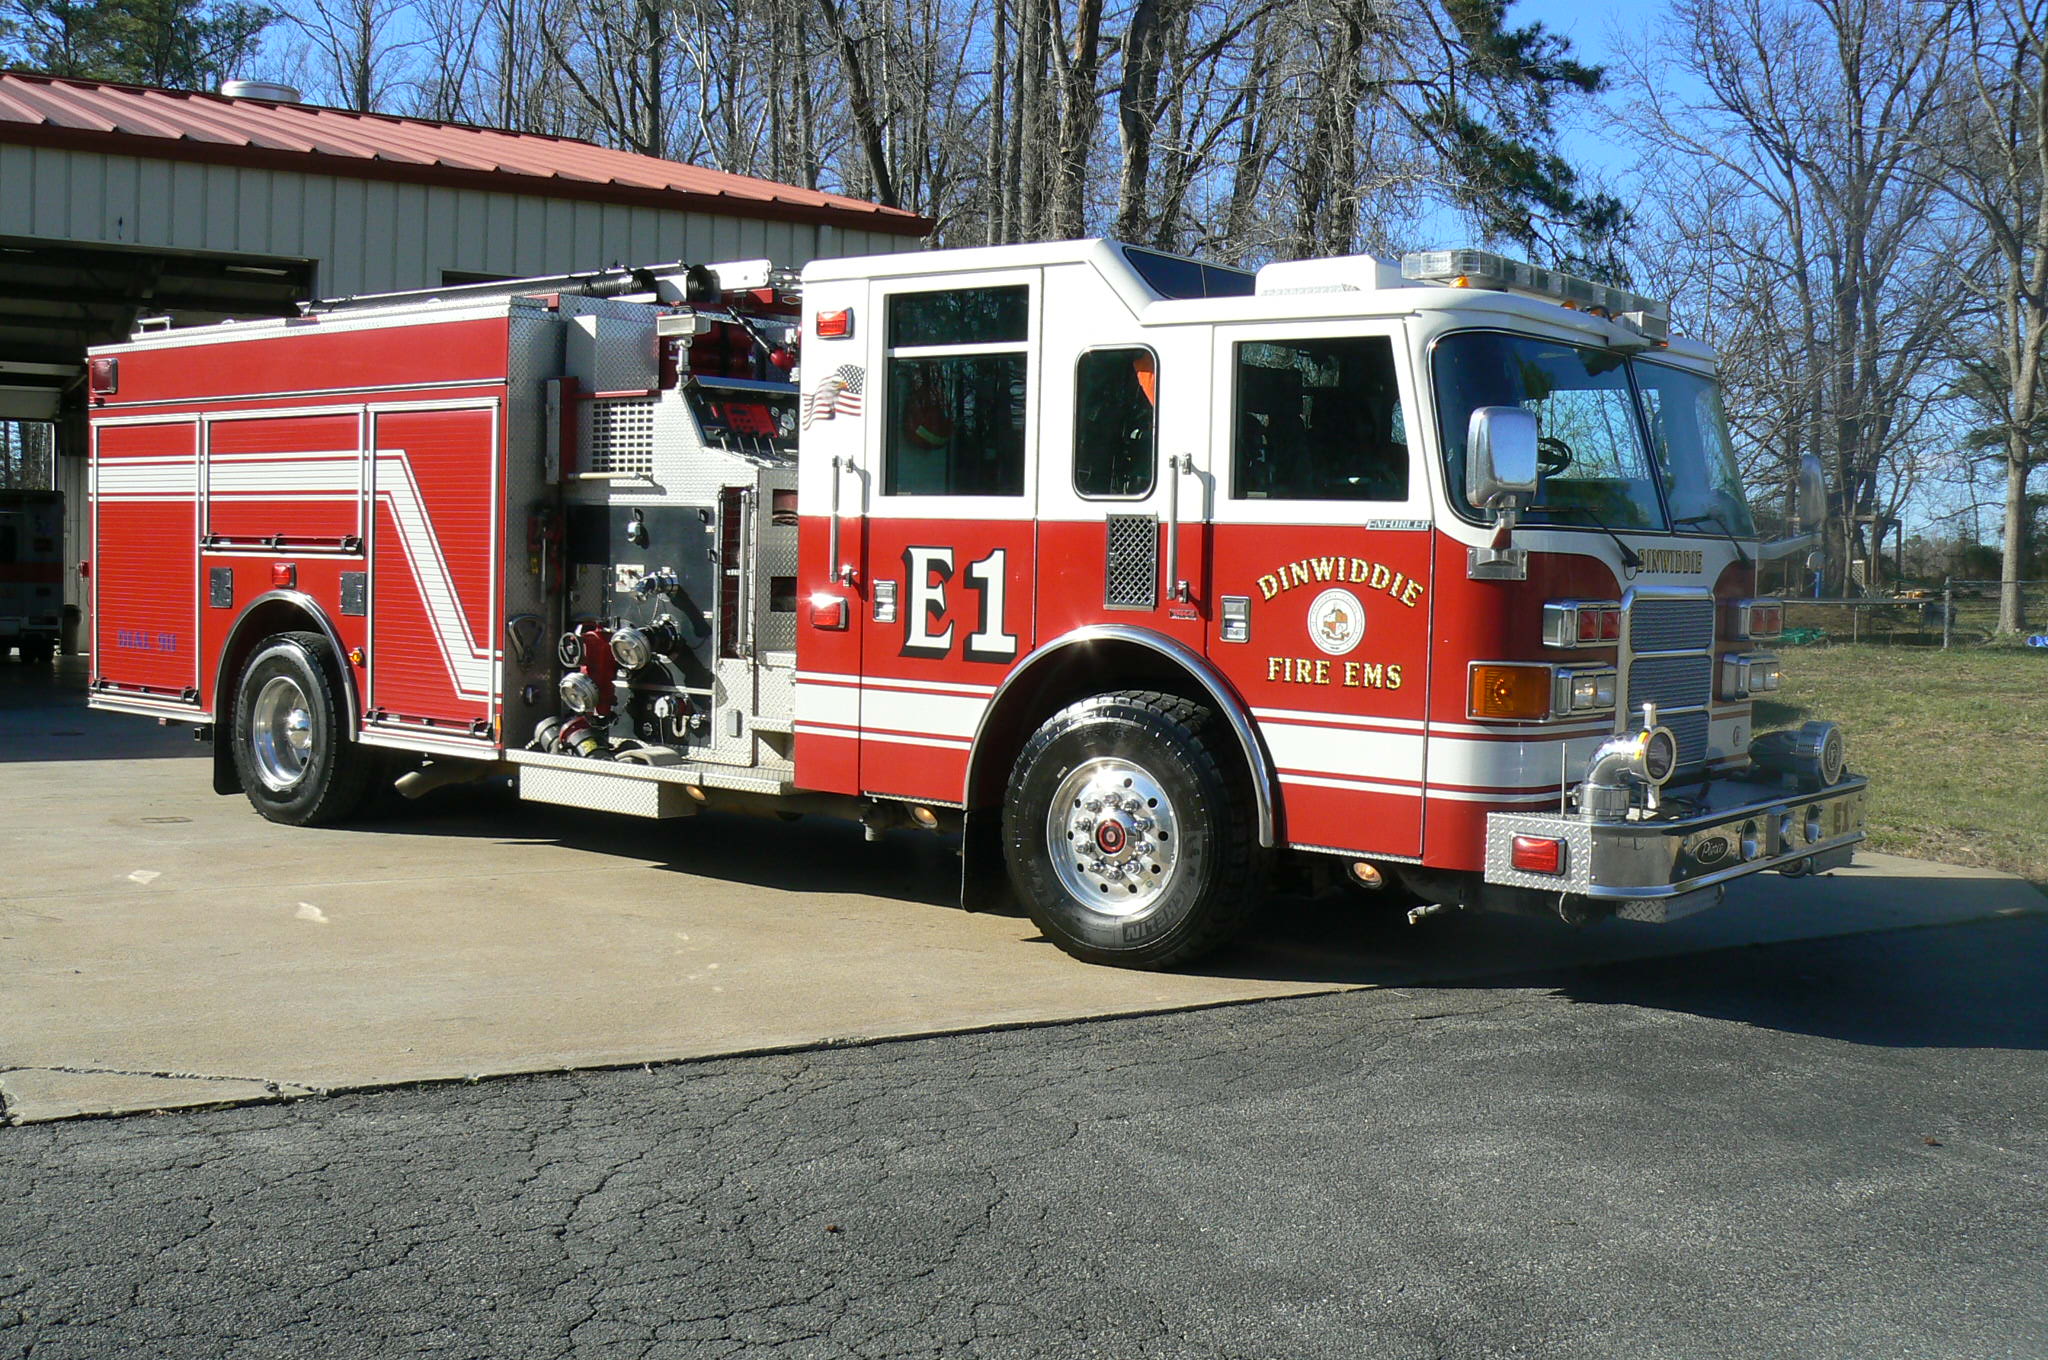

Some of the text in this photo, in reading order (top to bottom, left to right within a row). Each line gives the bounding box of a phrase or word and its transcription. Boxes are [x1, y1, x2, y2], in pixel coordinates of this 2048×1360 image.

[1366, 519, 1430, 531] ENFORCER
[1637, 548, 1703, 574] DINWIDDIE
[1256, 555, 1424, 607] DINWIDDIE
[900, 545, 1017, 662] E1
[118, 630, 150, 650] DIAL
[1267, 656, 1403, 691] FIRE EMS
